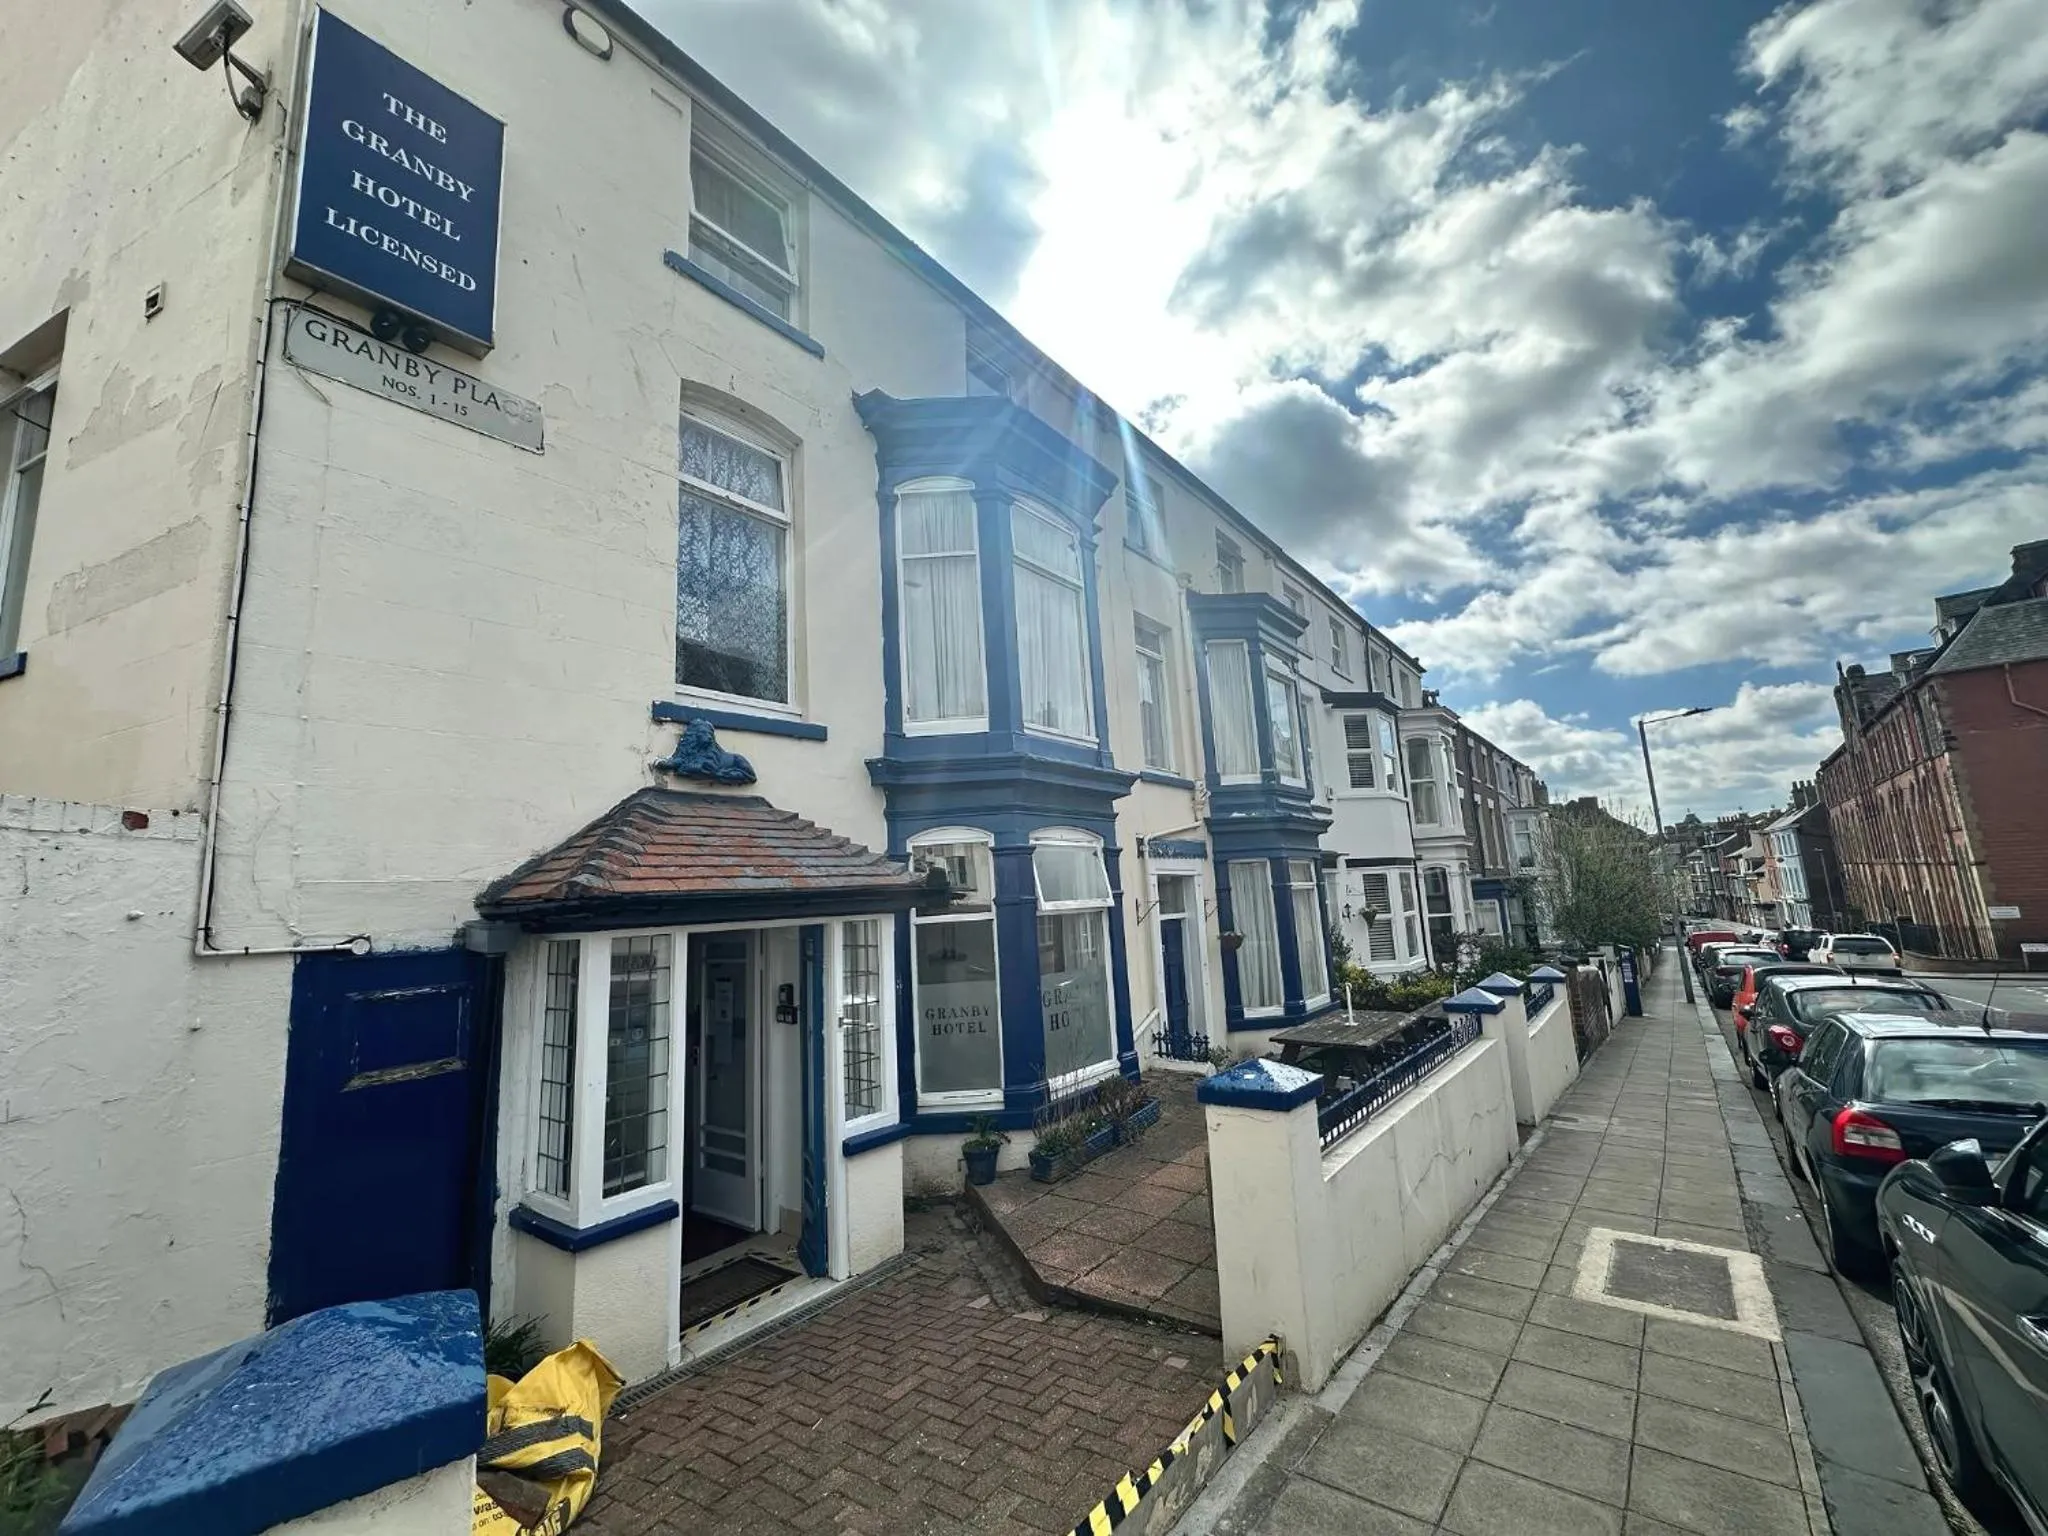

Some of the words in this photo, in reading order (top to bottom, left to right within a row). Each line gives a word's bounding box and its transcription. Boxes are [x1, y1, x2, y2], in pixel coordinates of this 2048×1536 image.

[383, 92, 447, 144] THE
[342, 119, 475, 202] GRANBY
[351, 169, 461, 241] HOTEL
[325, 207, 477, 292] LICENSED
[305, 319, 441, 385] GRANBY
[382, 375, 421, 400] NOS.
[925, 1005, 989, 1019] GRANBY
[930, 1022, 986, 1036] HOTEL
